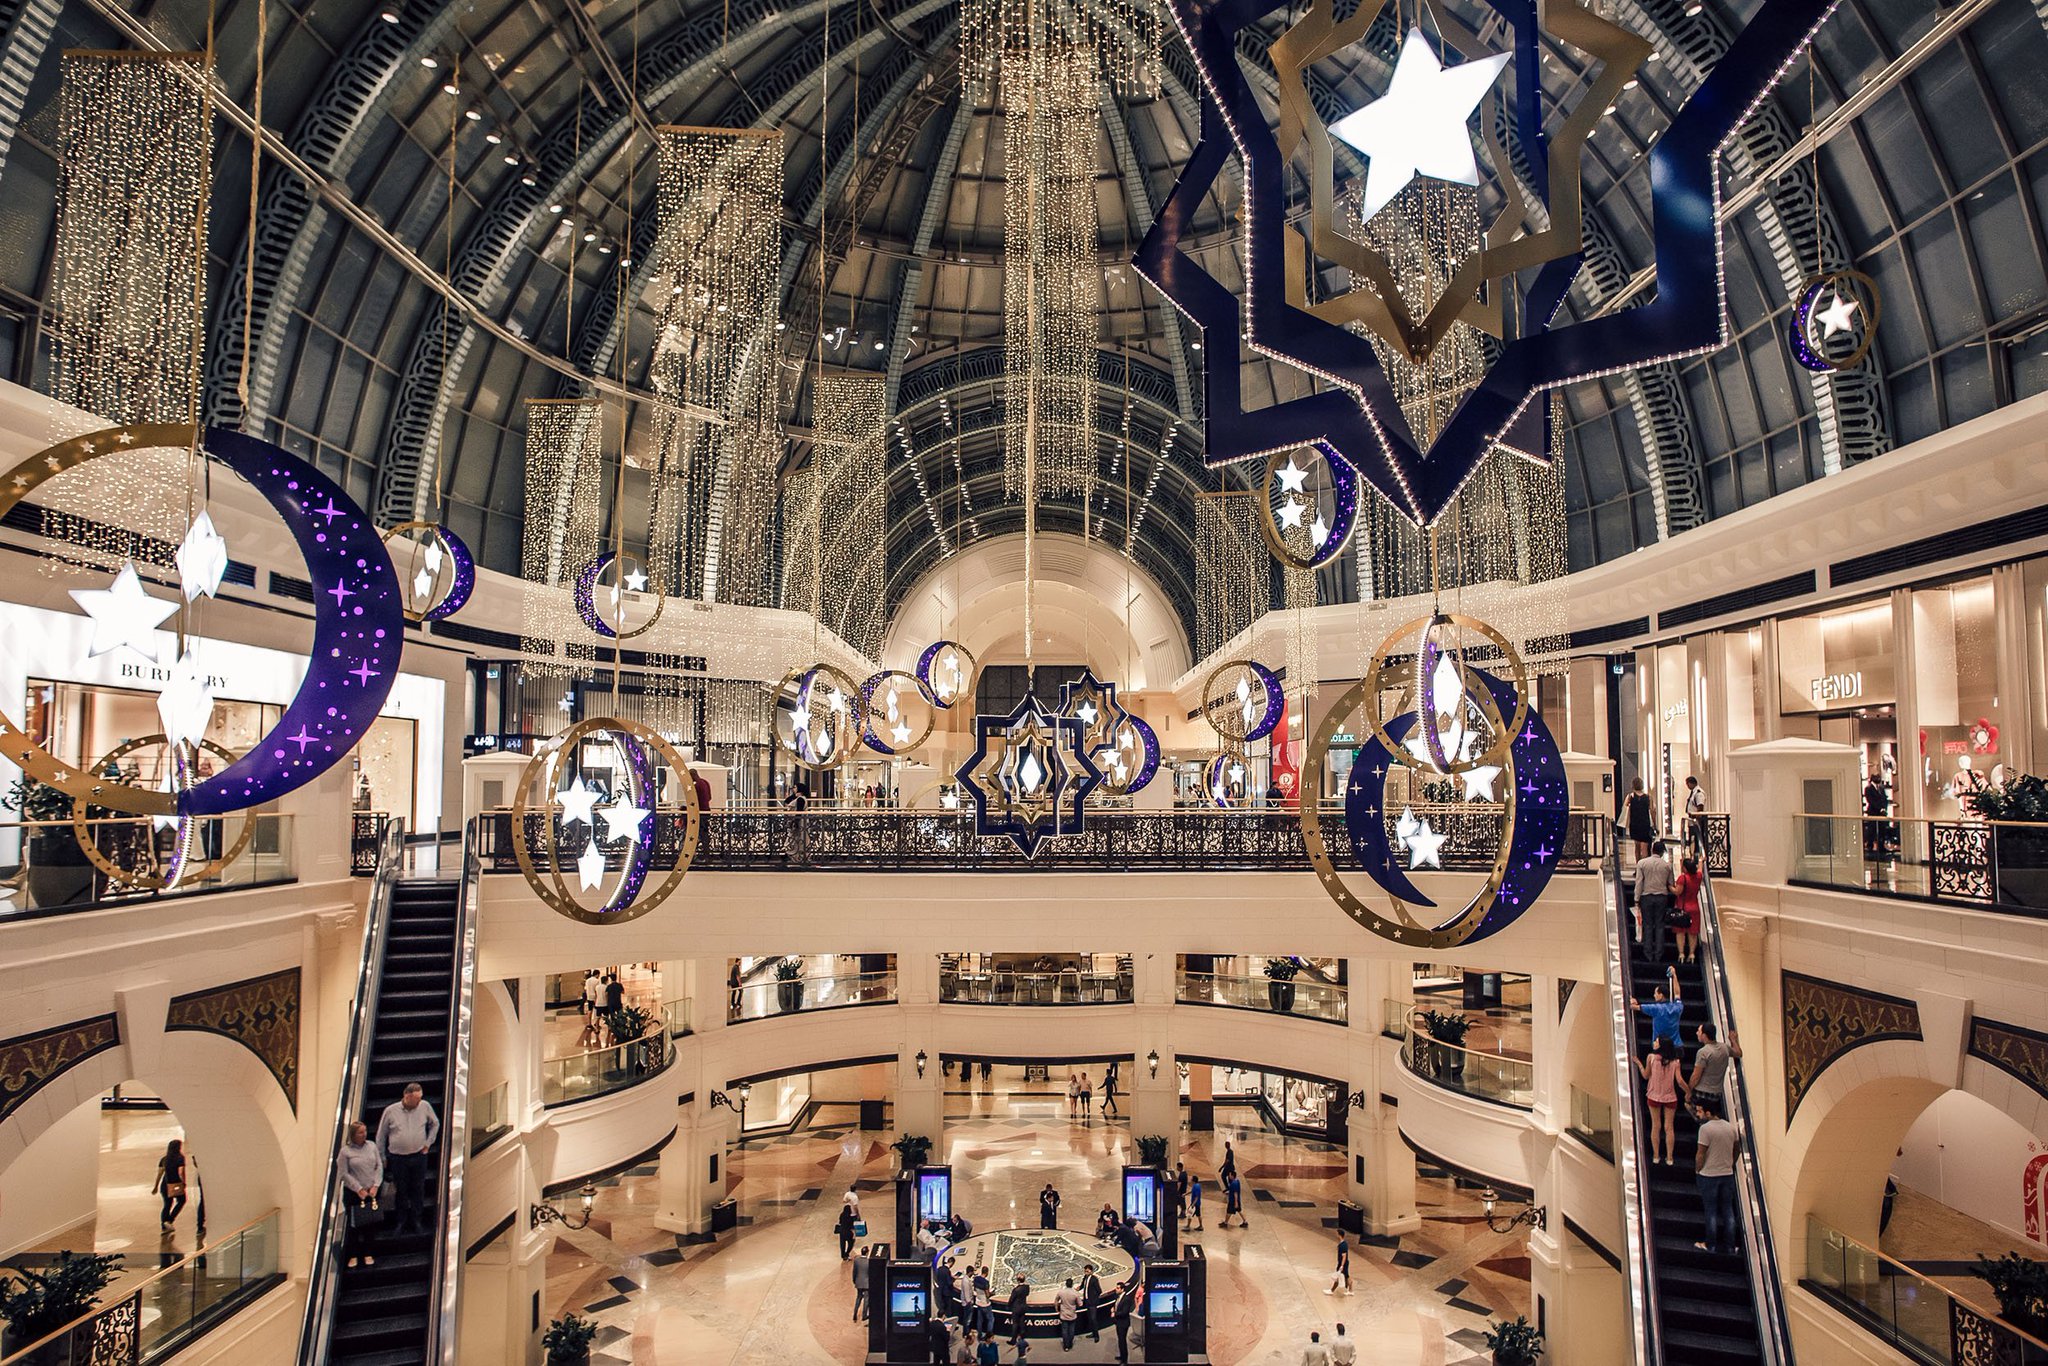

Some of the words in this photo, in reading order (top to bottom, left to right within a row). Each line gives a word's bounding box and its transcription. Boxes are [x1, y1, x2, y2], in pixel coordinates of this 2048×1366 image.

[121, 663, 229, 688] BURRY
[1811, 671, 1862, 702] FENDI
[1331, 734, 1355, 742] OLEX
